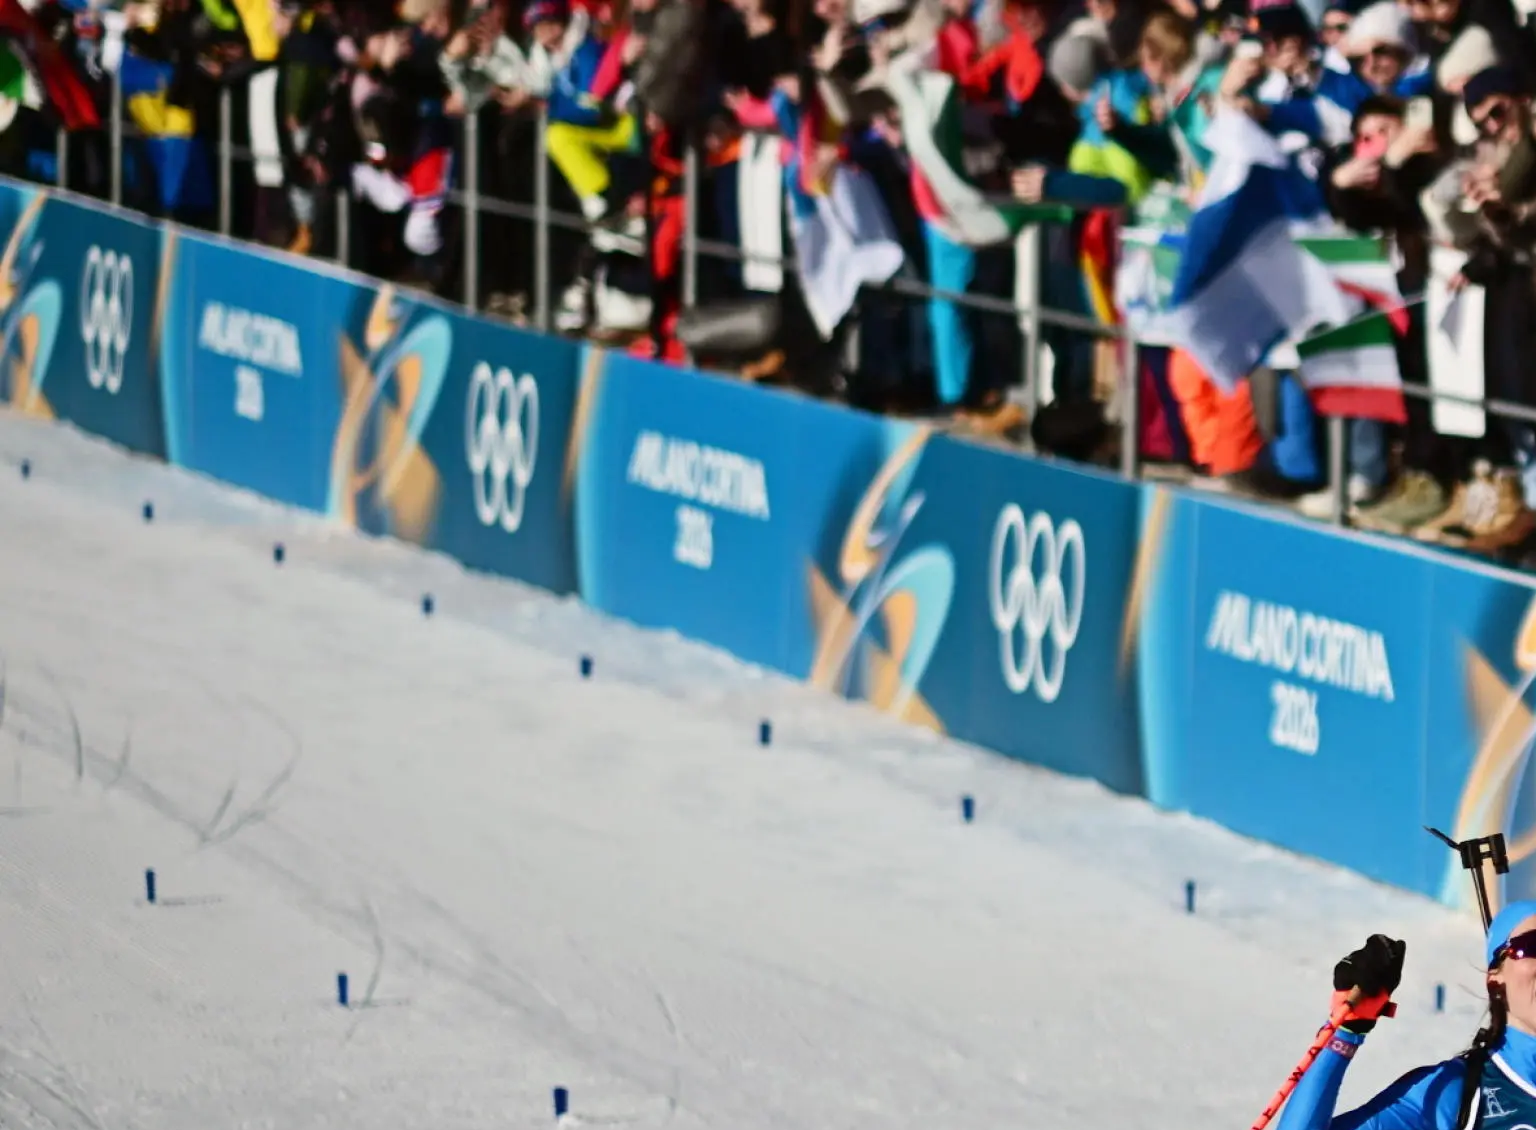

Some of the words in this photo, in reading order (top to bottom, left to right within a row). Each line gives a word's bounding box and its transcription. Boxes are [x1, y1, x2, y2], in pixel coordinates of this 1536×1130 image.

[1206, 590, 1298, 673] MILANO
[1299, 612, 1394, 702] CORTINA
[1271, 681, 1320, 756] 2026
